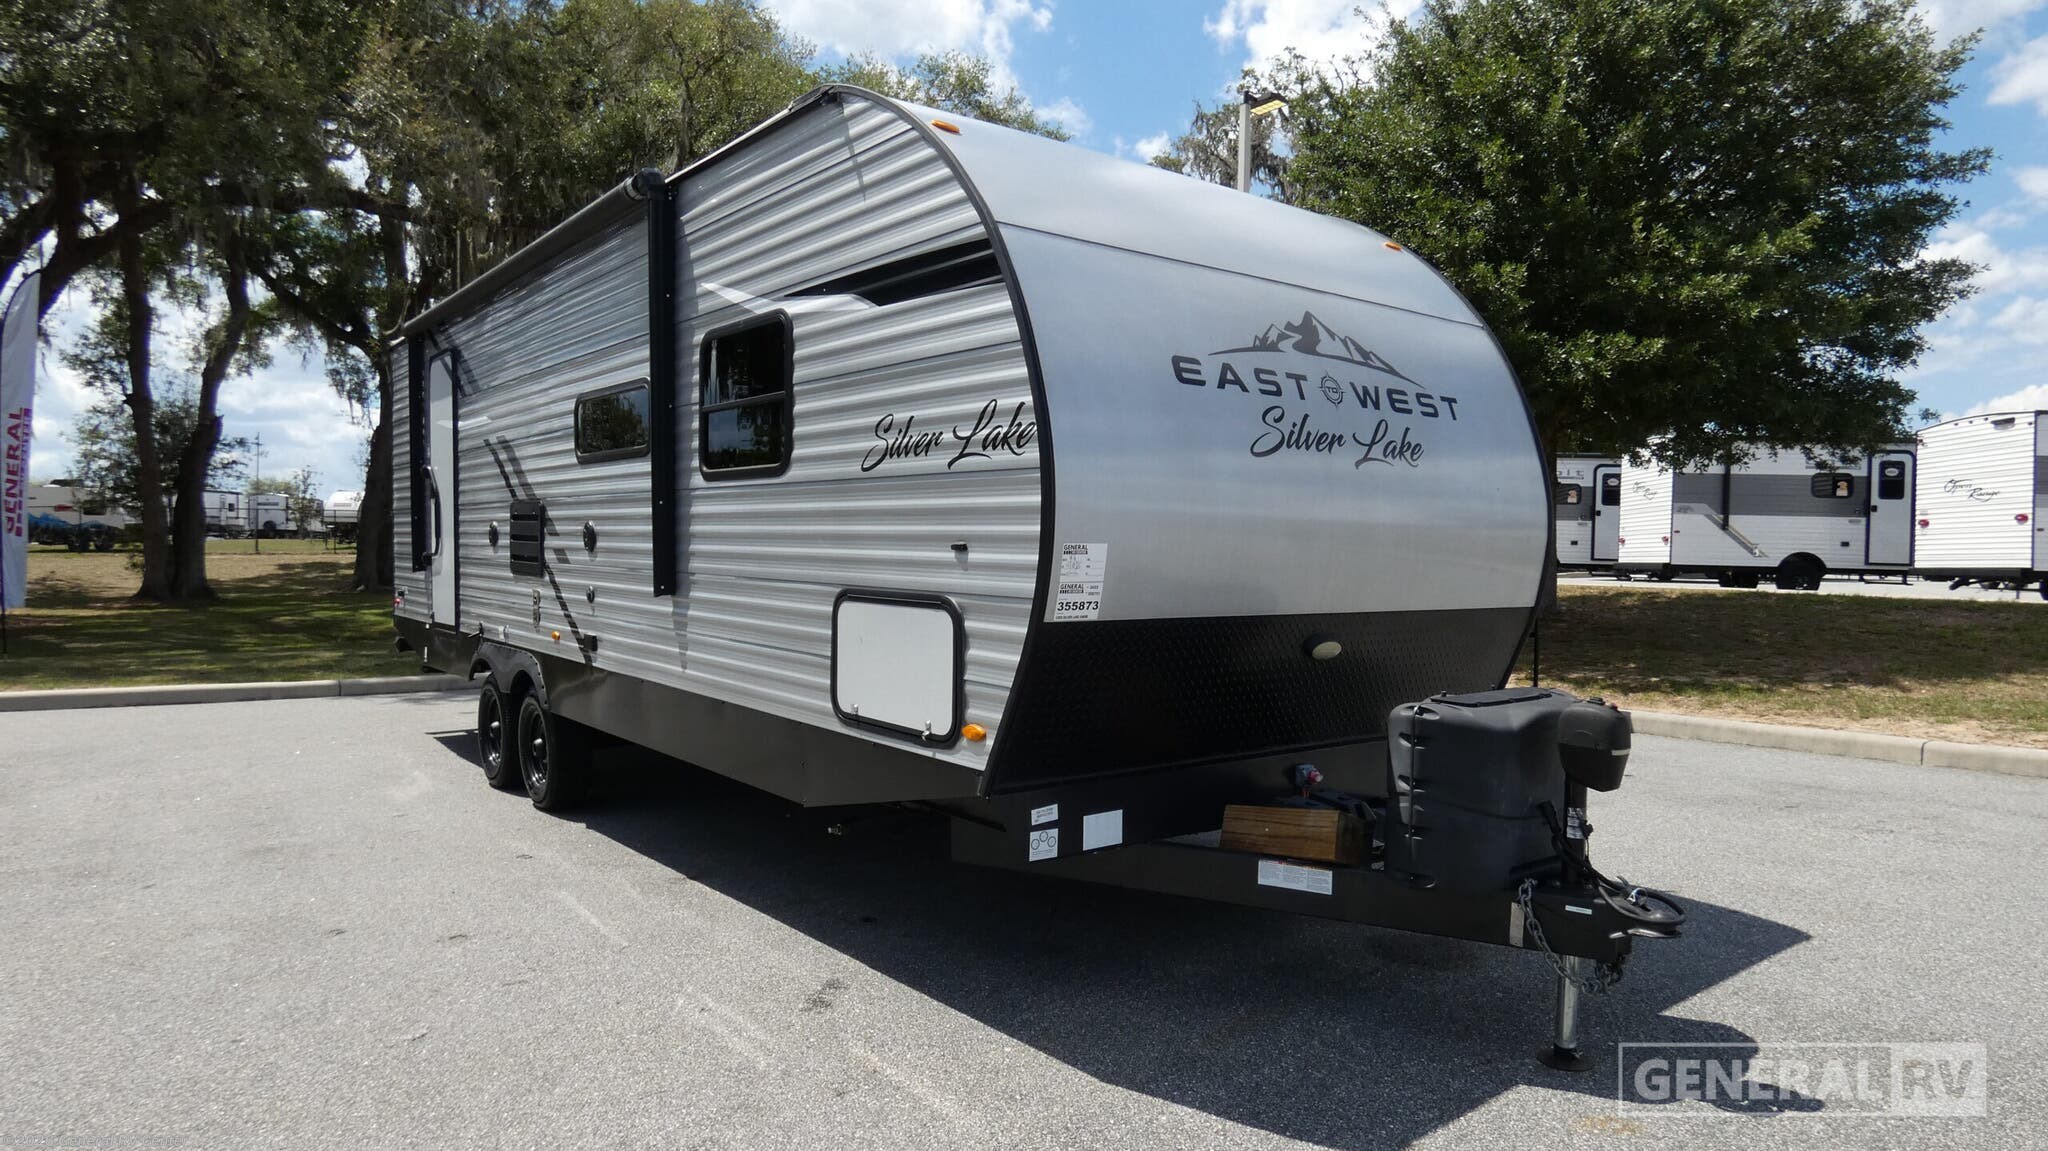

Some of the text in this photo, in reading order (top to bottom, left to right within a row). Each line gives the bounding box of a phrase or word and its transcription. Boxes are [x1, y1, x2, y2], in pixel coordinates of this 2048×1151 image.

[1171, 354, 1308, 401] EAST
[1349, 381, 1459, 421] WEST
[861, 398, 1037, 472] Silver Lake
[1250, 405, 1425, 470] Silver Lake
[1057, 600, 1099, 611] 355873
